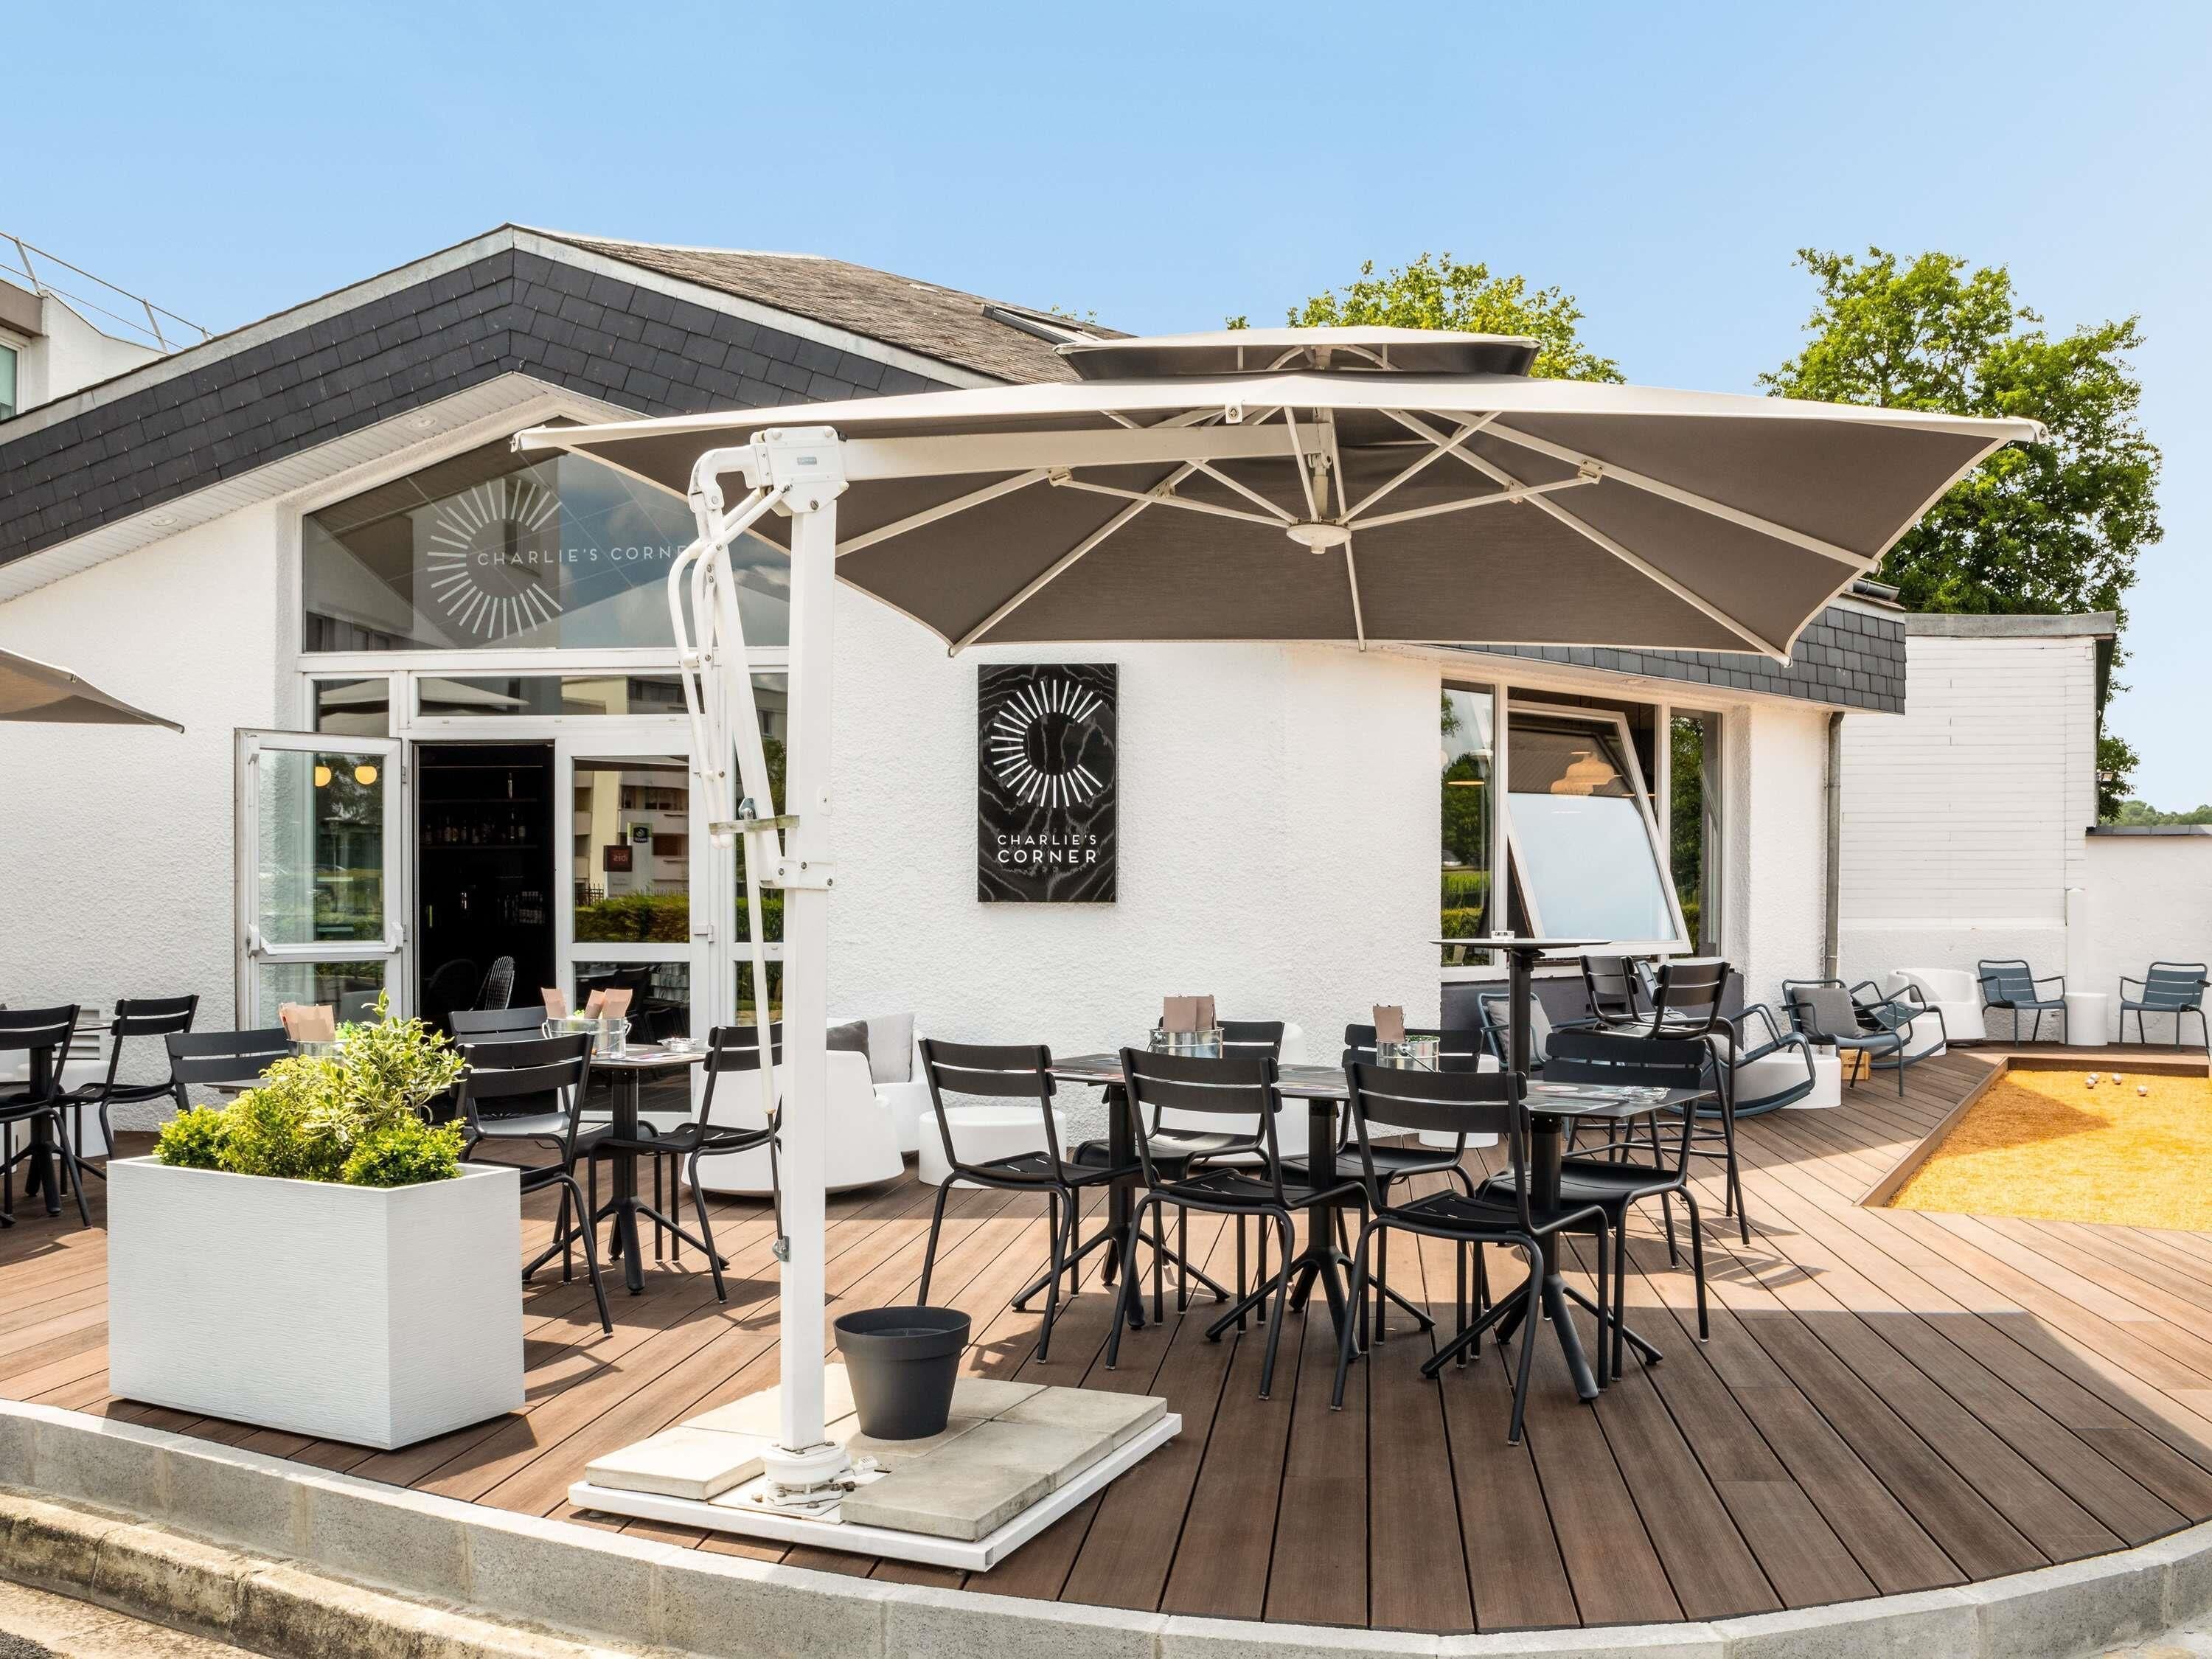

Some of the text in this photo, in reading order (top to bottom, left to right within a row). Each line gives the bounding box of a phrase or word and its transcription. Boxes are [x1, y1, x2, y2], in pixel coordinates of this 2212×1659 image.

[478, 548, 597, 566] CHARLIE'S
[998, 835, 1096, 845] CHARLIE'S
[998, 849, 1096, 863] CORNER
